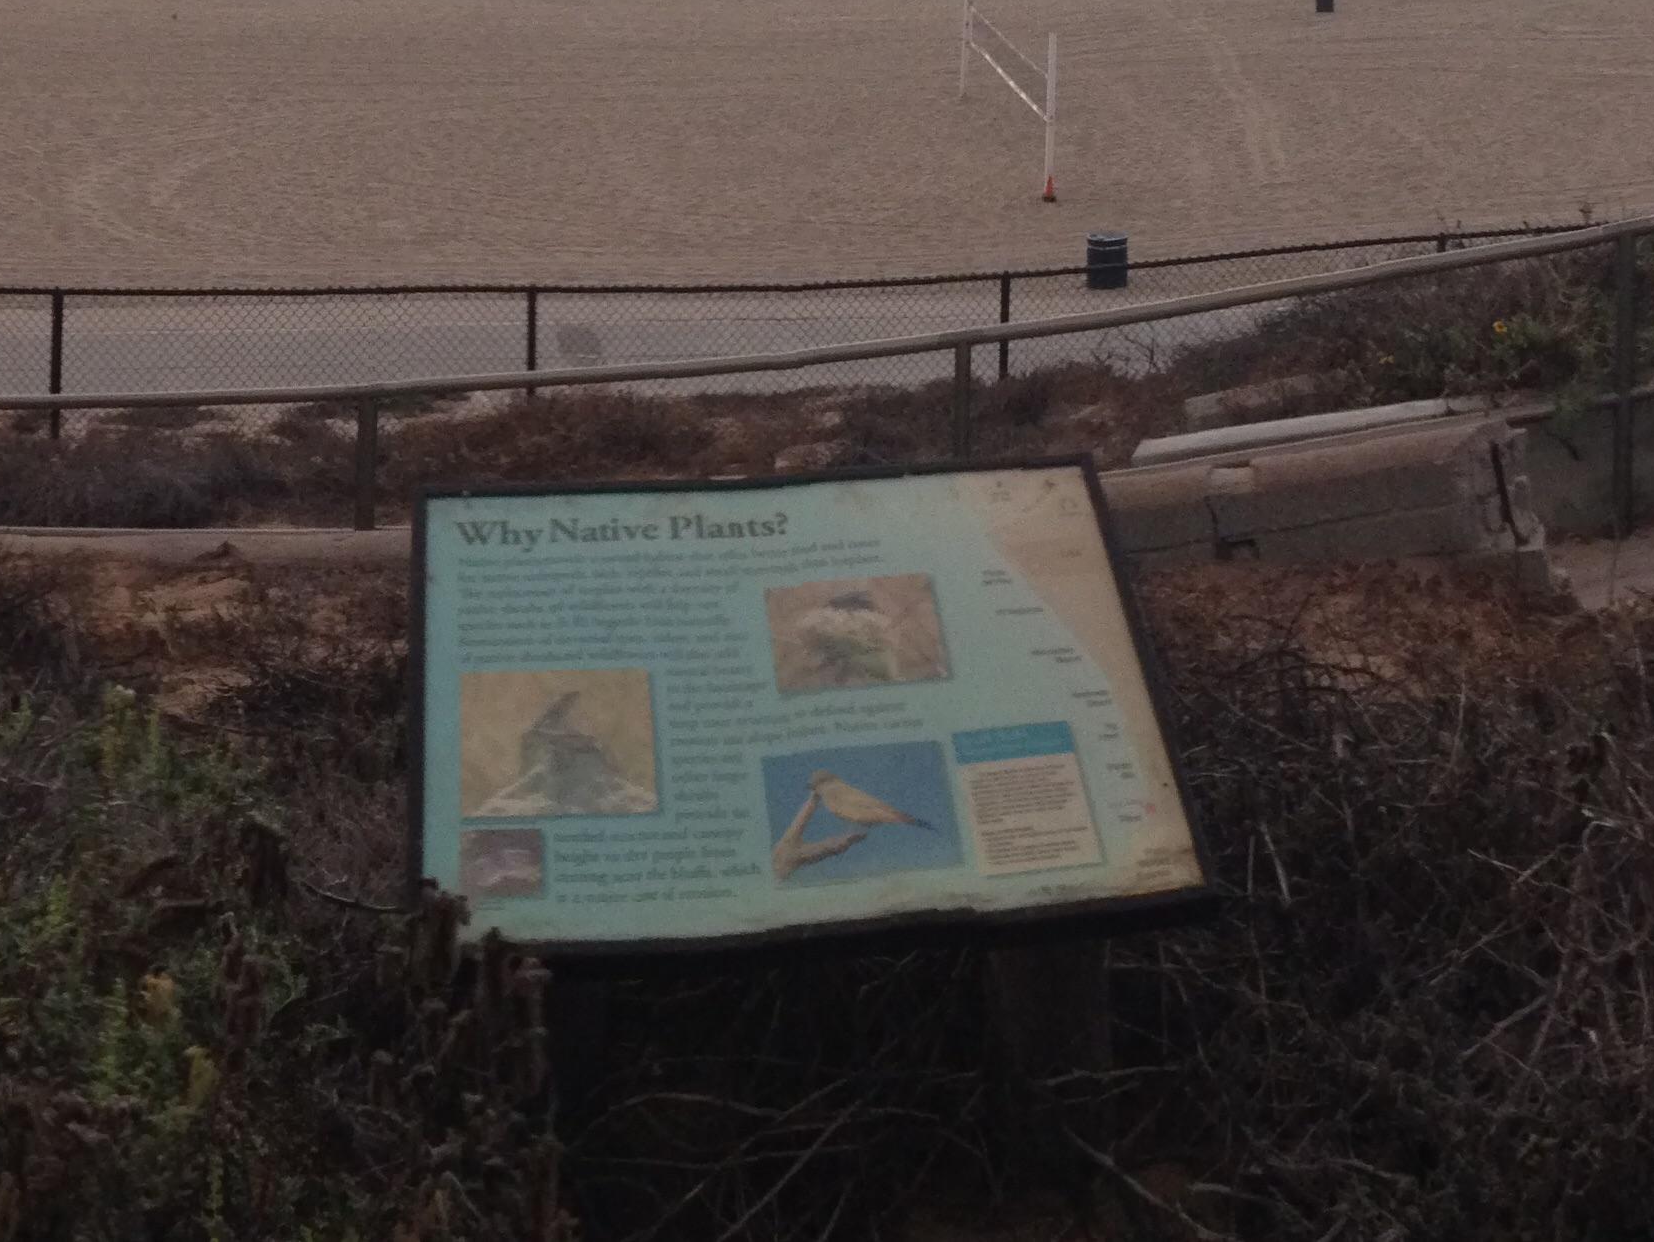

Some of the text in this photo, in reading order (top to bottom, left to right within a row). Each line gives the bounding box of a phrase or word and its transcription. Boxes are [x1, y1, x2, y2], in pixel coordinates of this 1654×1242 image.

[455, 511, 789, 553] Why Native Plants?
